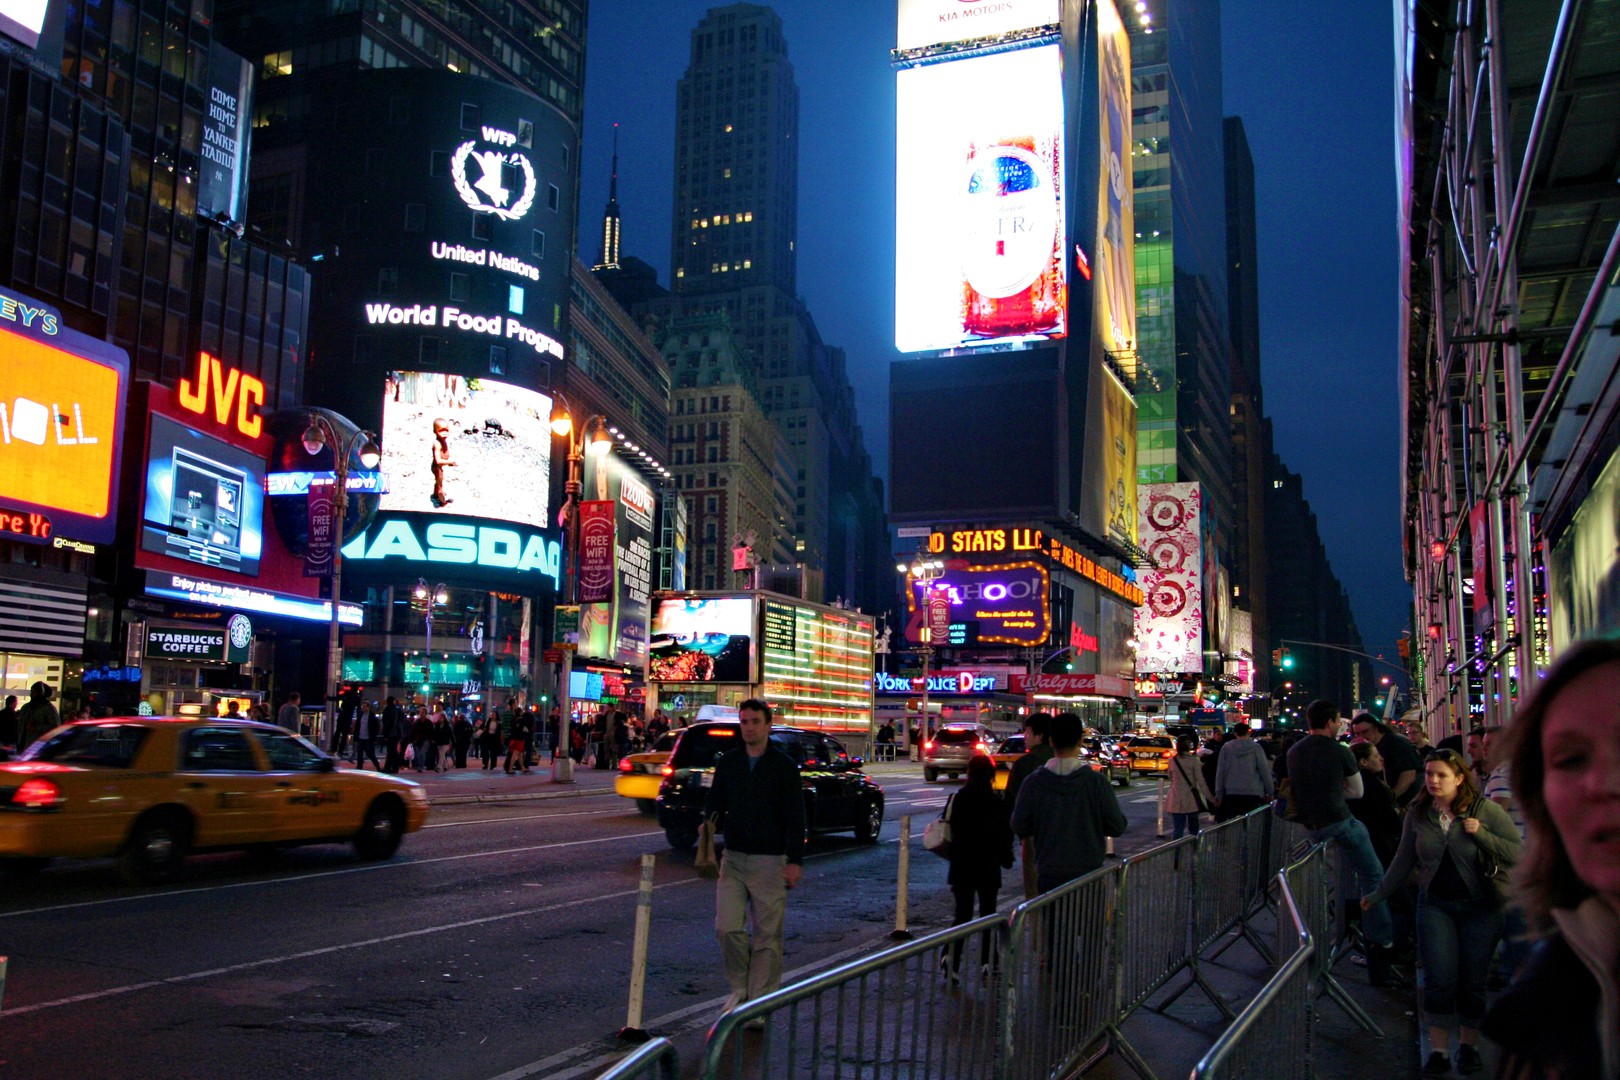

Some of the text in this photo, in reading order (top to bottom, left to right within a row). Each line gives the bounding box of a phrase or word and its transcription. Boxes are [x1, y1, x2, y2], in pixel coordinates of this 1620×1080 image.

[939, 2, 1012, 22] KIA MOTORS
[211, 87, 236, 111] COME
[209, 103, 235, 128] HOME
[218, 122, 226, 133] TO
[481, 126, 517, 147] WFP
[431, 241, 540, 281] United Nations
[366, 303, 564, 360] World Food Program
[179, 350, 264, 439] JVC
[312, 515, 331, 525] FREE
[313, 526, 329, 536] WIFI
[952, 529, 1006, 552] STATS
[1013, 528, 1043, 550] LLC
[585, 535, 609, 546] FREE
[586, 547, 607, 558] WIFI
[172, 576, 197, 591] Enjoy
[196, 581, 222, 593] picture
[149, 632, 224, 646] STARBUCKS
[162, 642, 210, 654] COFFEE
